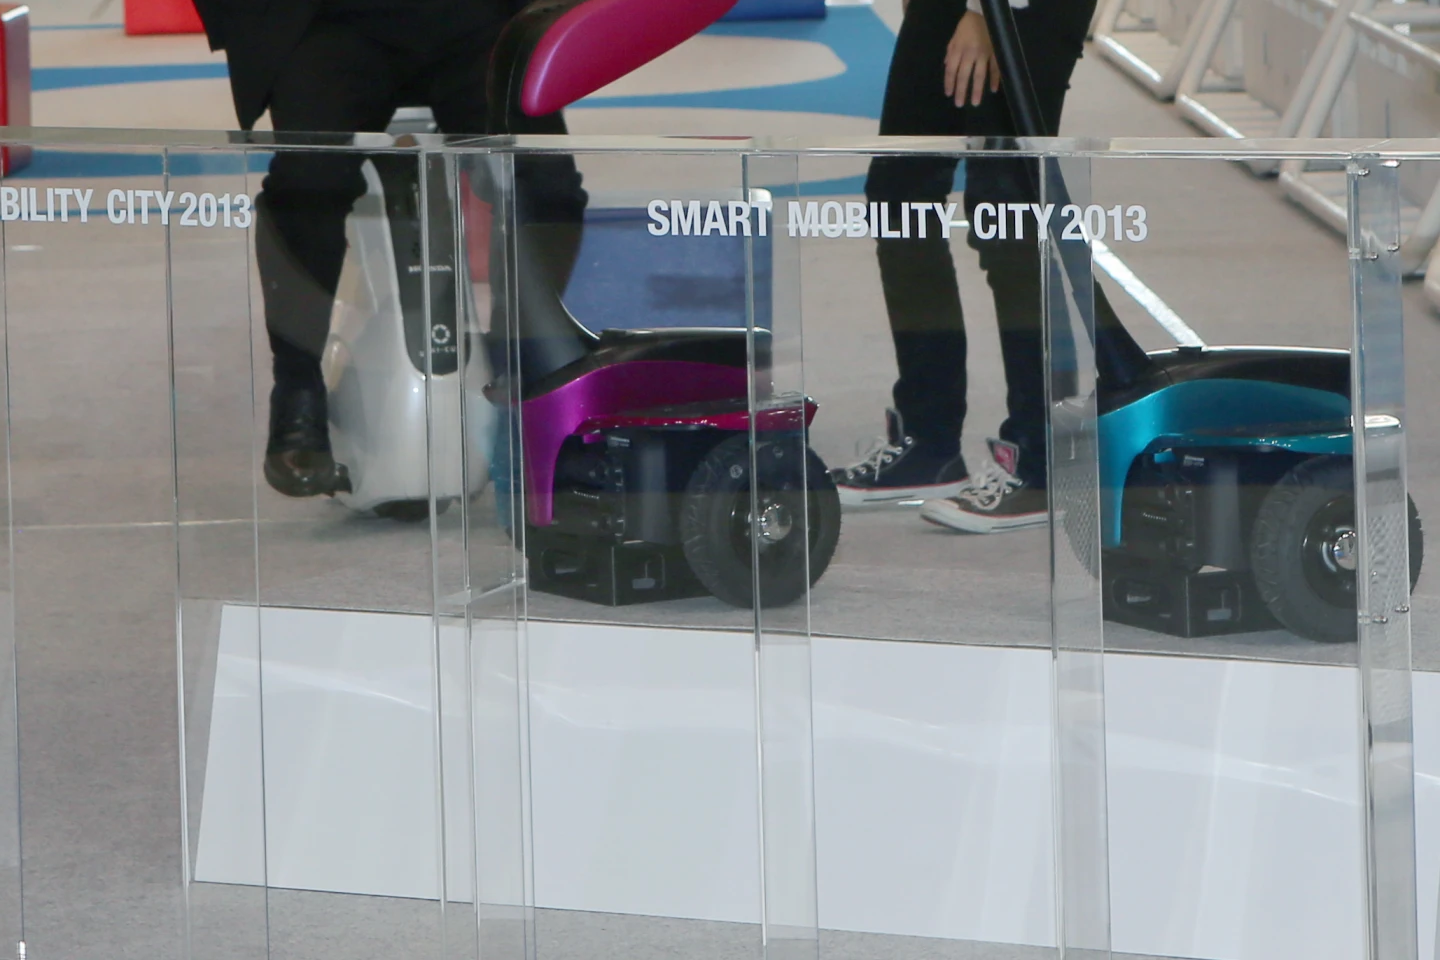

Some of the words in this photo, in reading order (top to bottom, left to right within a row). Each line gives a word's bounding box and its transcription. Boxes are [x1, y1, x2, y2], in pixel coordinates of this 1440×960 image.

[107, 188, 174, 225] CITY
[179, 192, 252, 228] 2013
[647, 199, 769, 237] SMART
[787, 201, 958, 239] MOBILITY
[973, 202, 1054, 241] CITY
[1060, 204, 1148, 243] 2013
